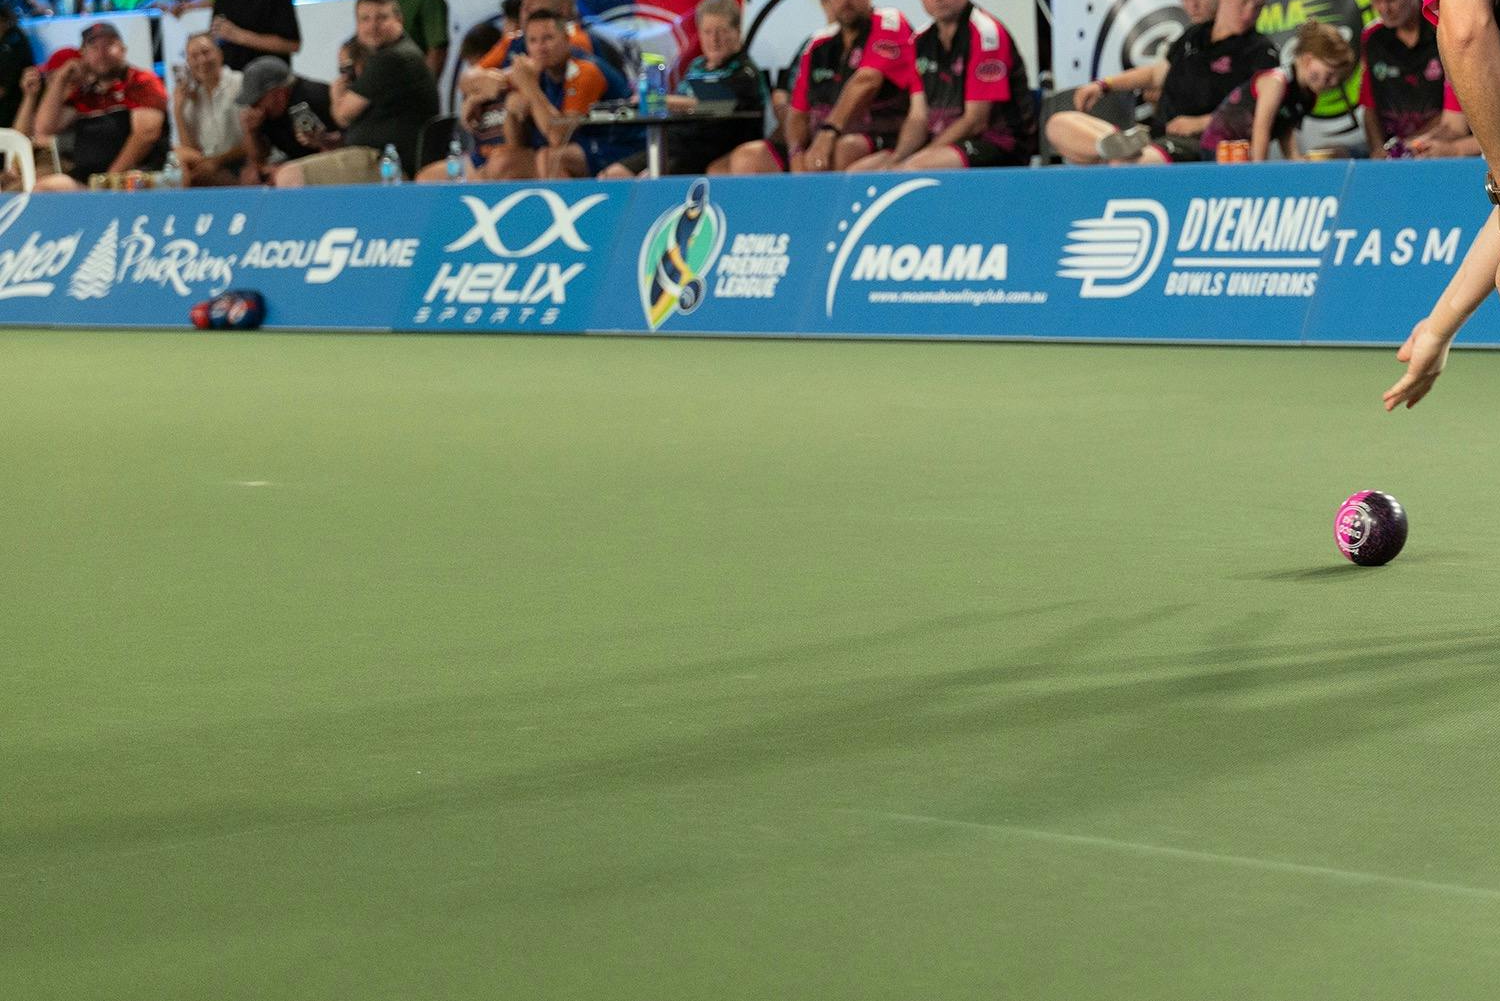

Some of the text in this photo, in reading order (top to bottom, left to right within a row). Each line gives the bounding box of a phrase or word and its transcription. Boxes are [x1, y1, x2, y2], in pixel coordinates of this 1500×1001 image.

[131, 213, 247, 237] CLUB
[1177, 196, 1339, 253] DYENAMIC
[851, 242, 1008, 281] MOAMA
[1164, 271, 1318, 297] BOWLS UNIFORMS
[413, 306, 560, 325] SPORTS
